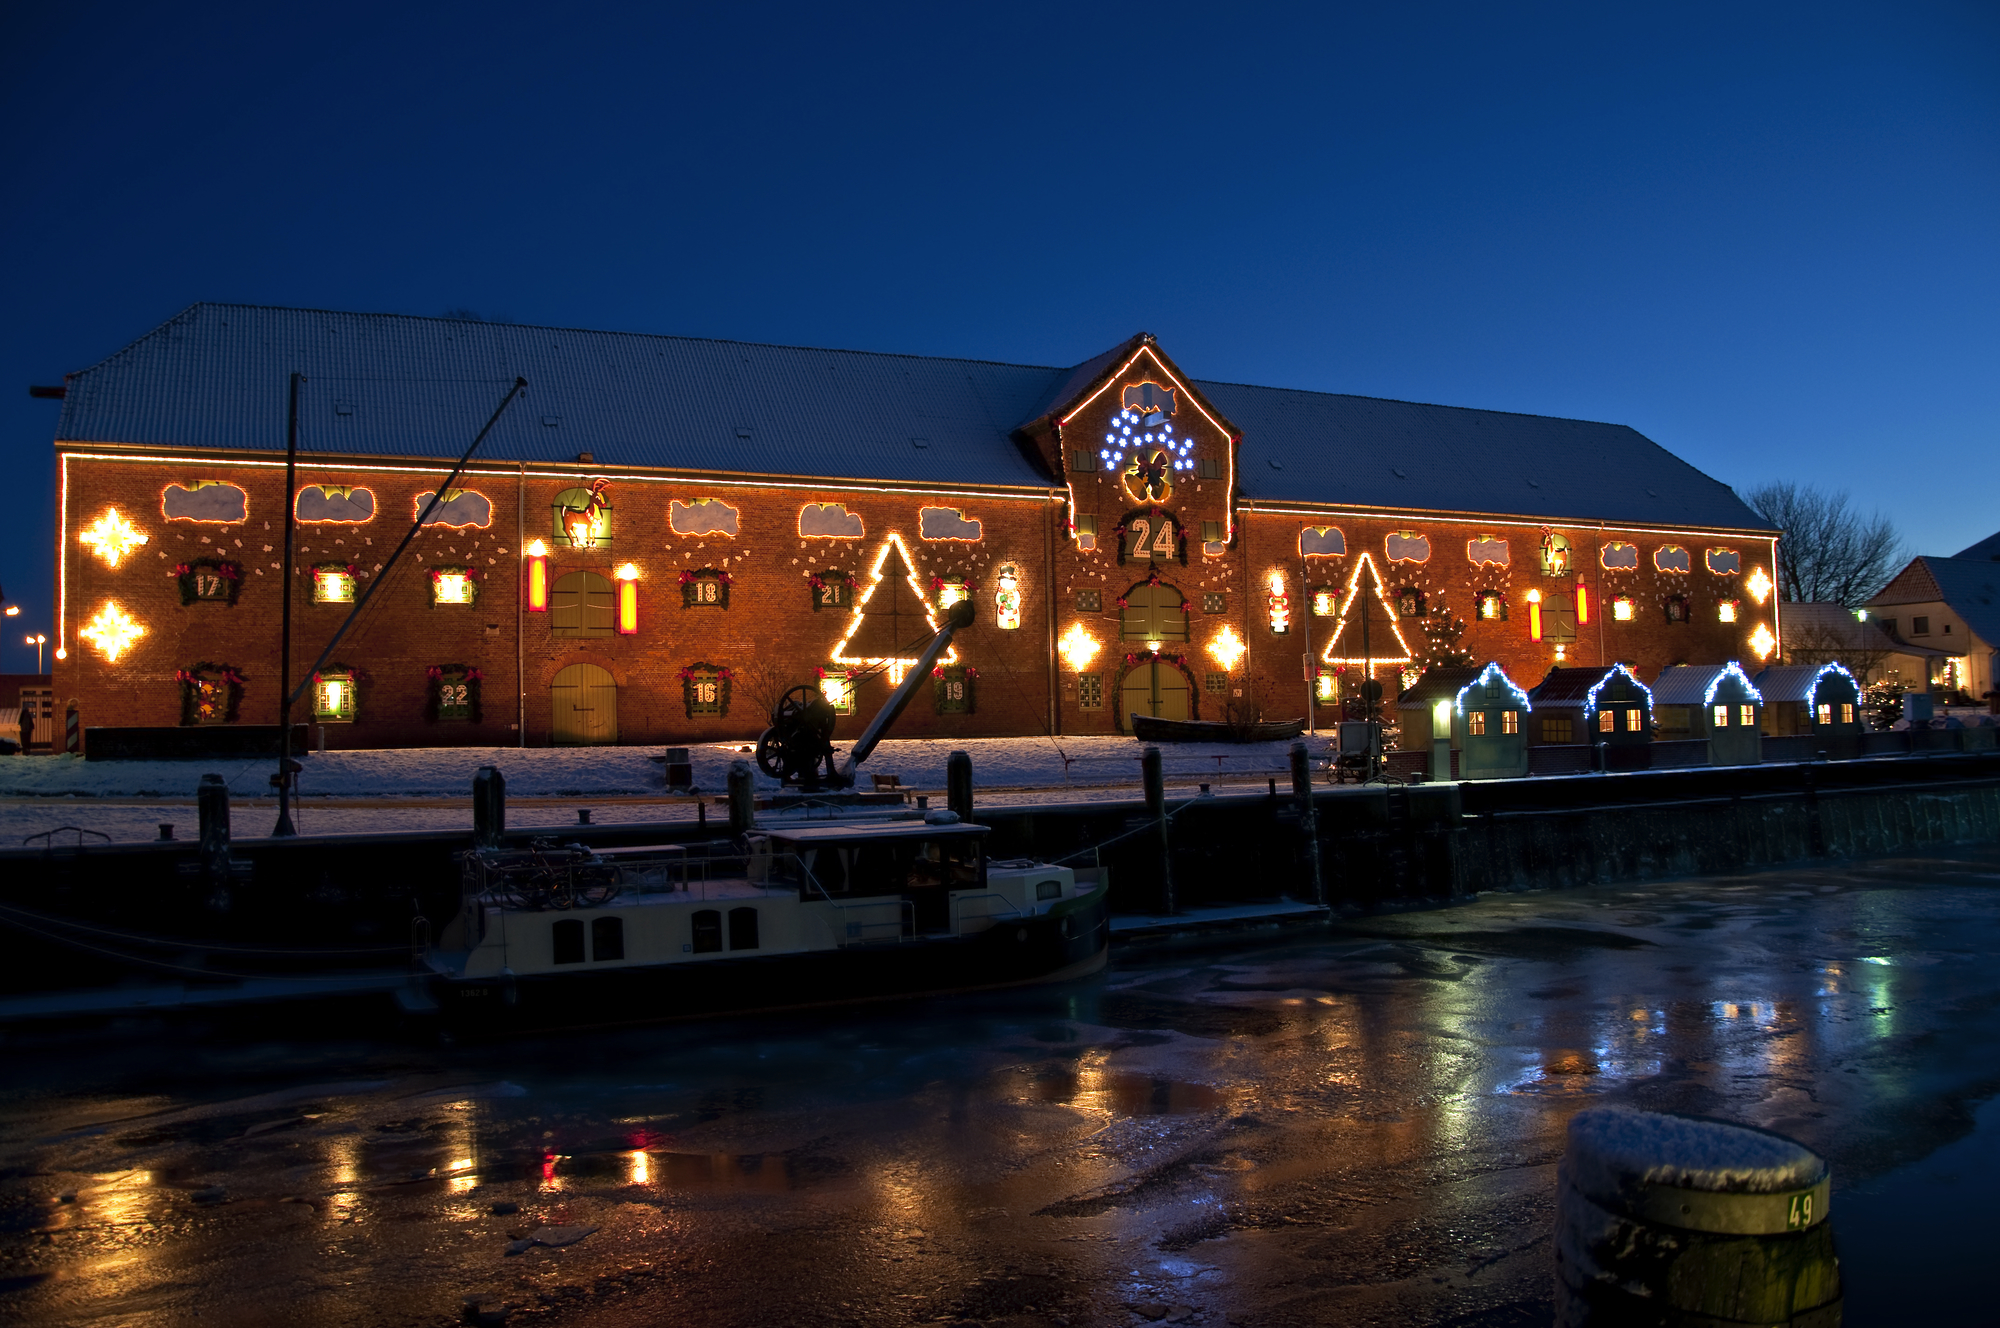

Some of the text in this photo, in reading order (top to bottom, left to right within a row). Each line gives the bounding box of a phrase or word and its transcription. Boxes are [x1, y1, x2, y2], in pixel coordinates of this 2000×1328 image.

[1132, 519, 1175, 560] 24
[195, 574, 220, 596] 17
[696, 582, 717, 602] 18
[821, 585, 840, 604] 21
[1401, 598, 1416, 614] 23
[441, 684, 468, 706] 22
[693, 683, 716, 703] 16
[946, 682, 964, 700] 19
[1789, 1195, 1812, 1227] 49
